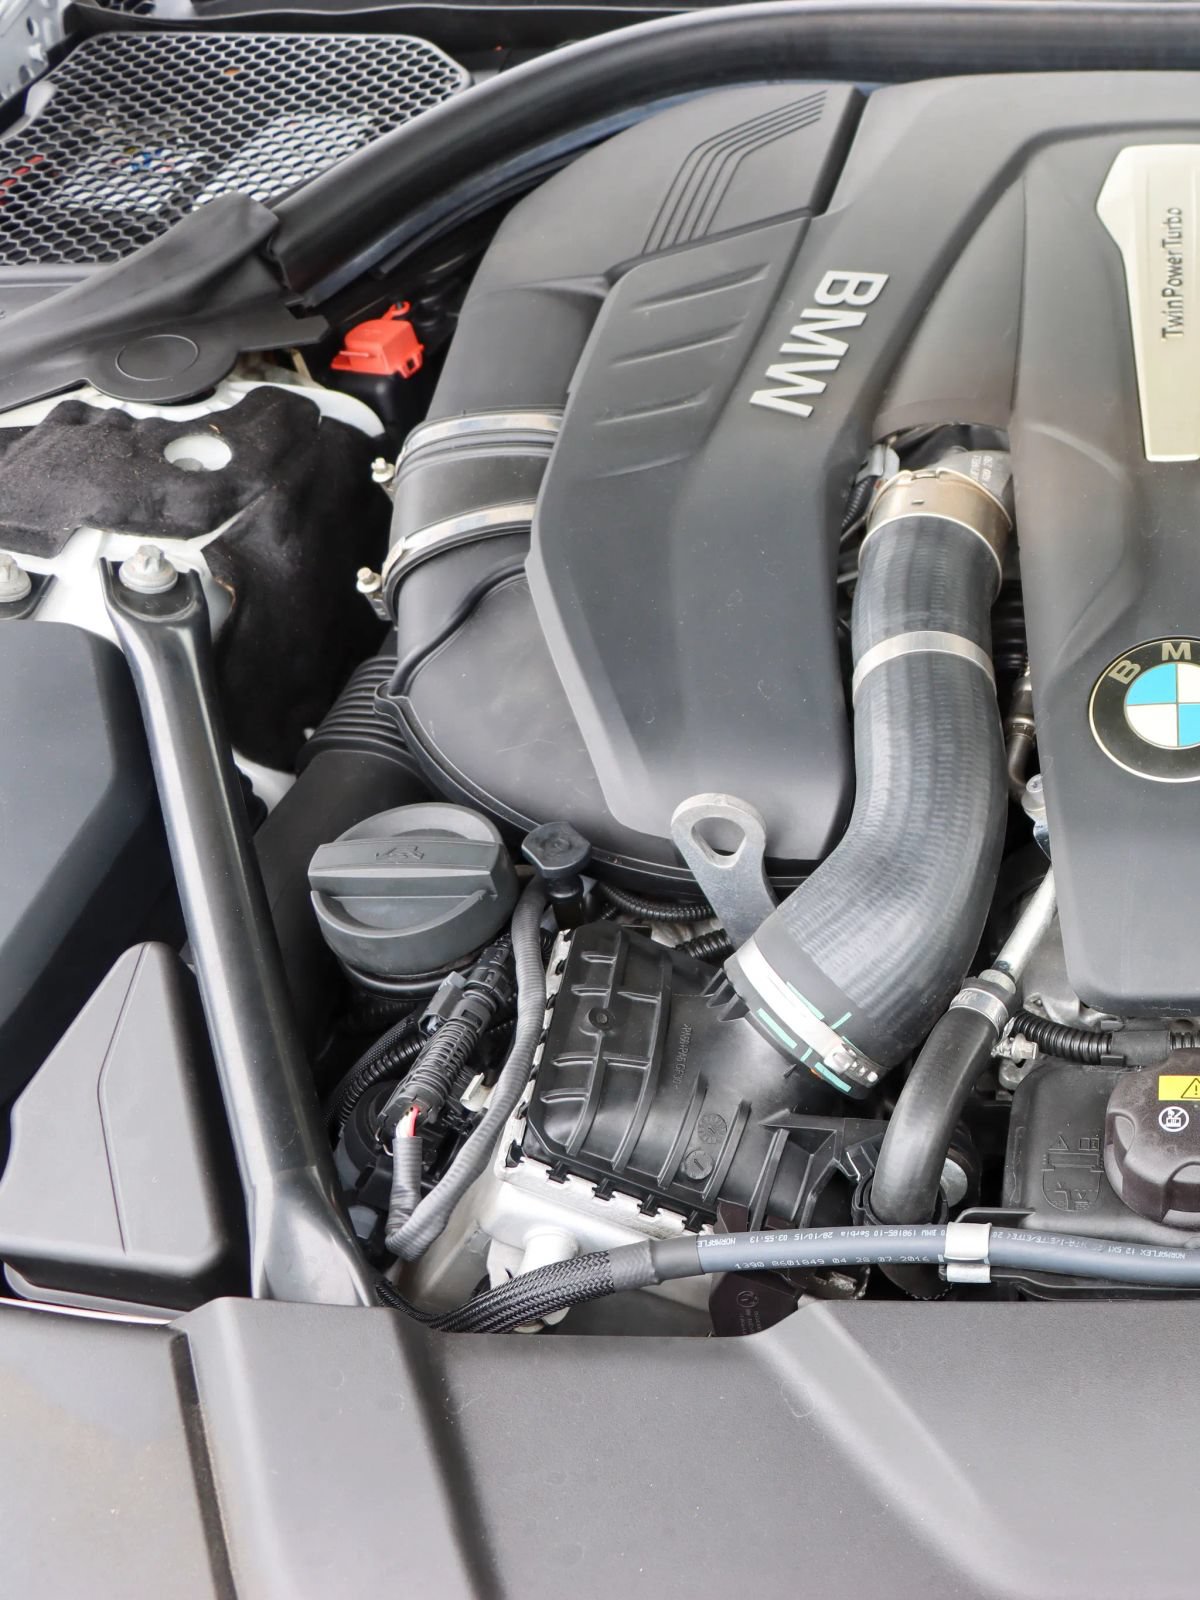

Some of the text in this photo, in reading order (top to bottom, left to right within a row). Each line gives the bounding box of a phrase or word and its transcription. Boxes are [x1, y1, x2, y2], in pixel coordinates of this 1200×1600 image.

[748, 270, 889, 418] BMW
[840, 1229, 871, 1239] Serbia
[921, 1228, 937, 1237] BMW
[1139, 1248, 1186, 1260] NORMAFLEX
[734, 1260, 765, 1270] 1390
[831, 1256, 847, 1265] 04
